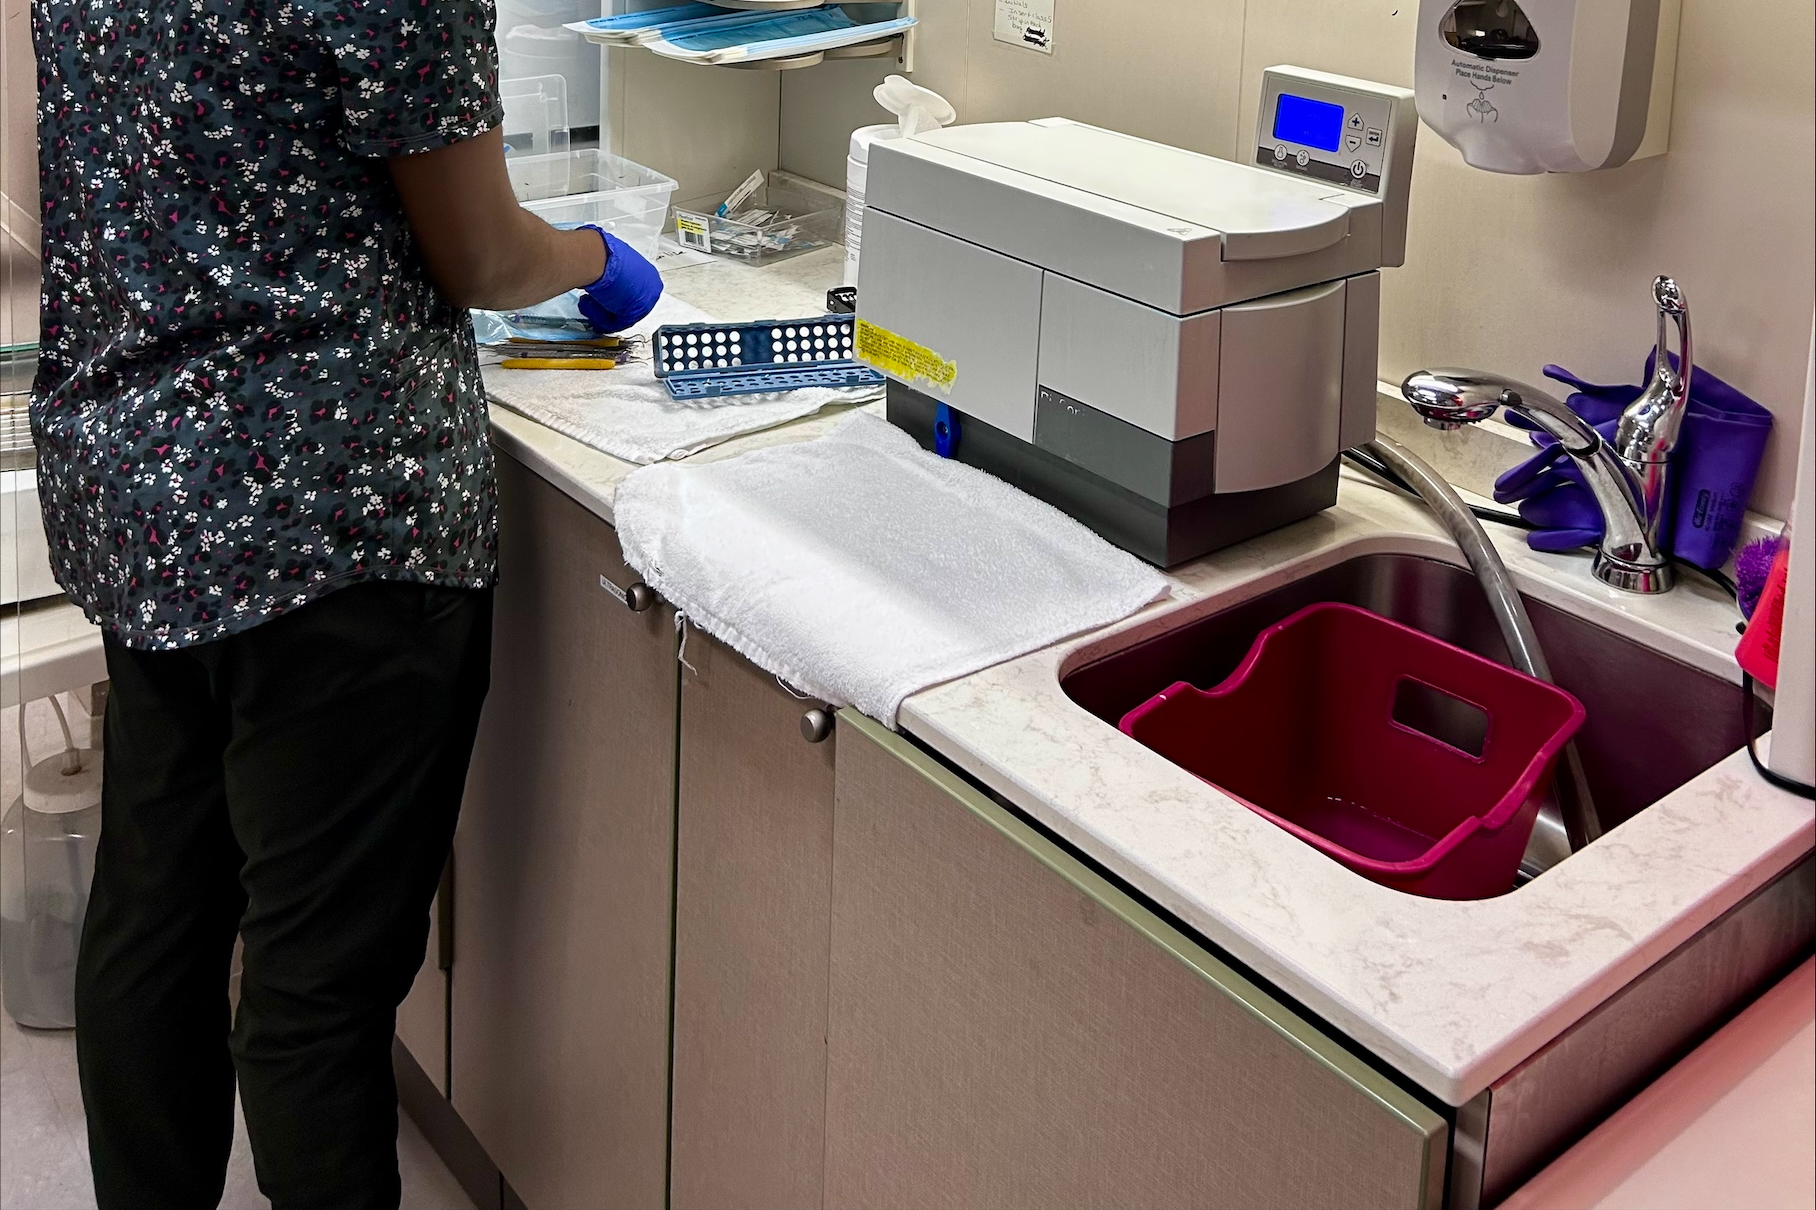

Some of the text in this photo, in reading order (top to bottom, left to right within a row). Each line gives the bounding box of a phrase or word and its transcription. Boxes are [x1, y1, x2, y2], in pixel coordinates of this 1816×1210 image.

[1451, 60, 1519, 77] Automatic Dispenser
[1455, 68, 1513, 85] Place Hands Below
